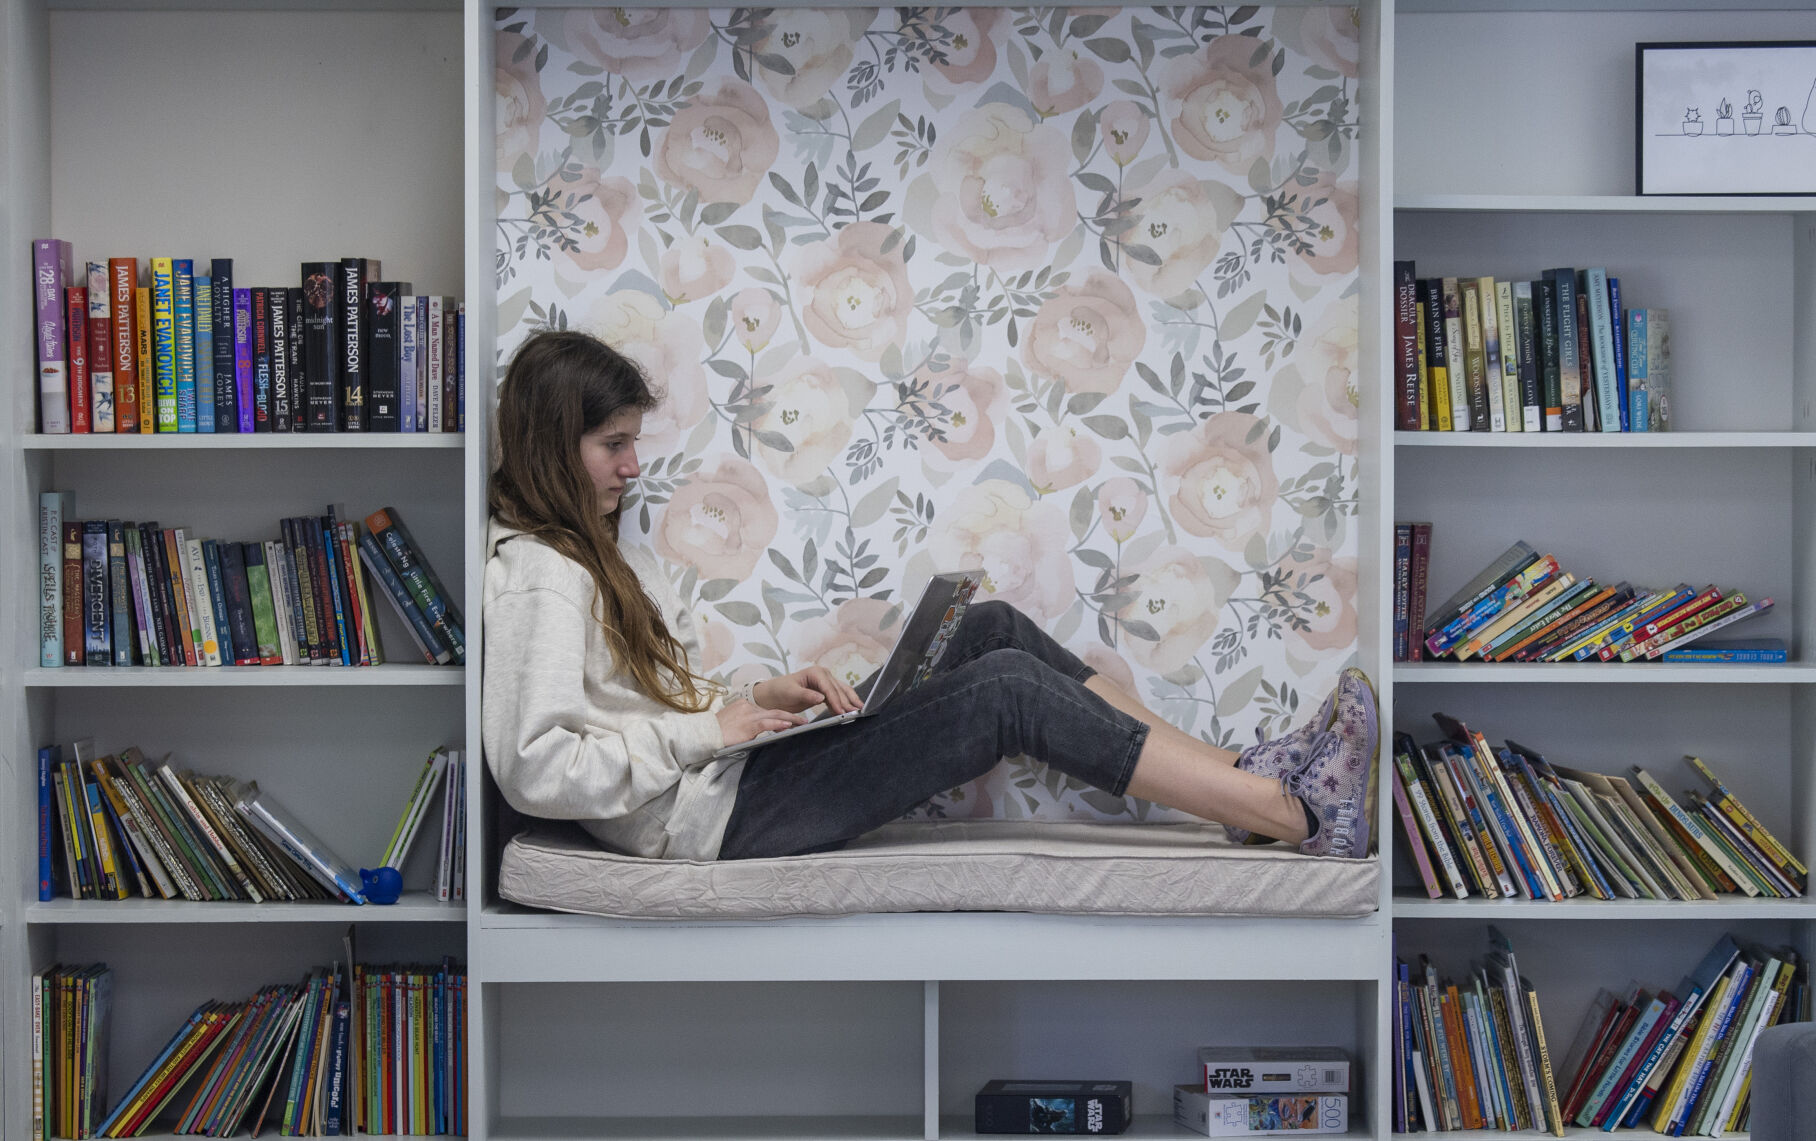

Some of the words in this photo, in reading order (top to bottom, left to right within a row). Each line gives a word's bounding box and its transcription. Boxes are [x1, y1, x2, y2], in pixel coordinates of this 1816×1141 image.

[38, 269, 55, 301] 28-DAY
[116, 266, 130, 301] JAMES
[154, 271, 171, 314] JANET
[175, 271, 192, 308] JANET
[196, 284, 212, 307] JANET
[345, 267, 357, 303] JAMES
[1561, 282, 1569, 301] THE
[222, 287, 230, 328] HIGHER
[256, 292, 264, 319] PATRICIA
[403, 304, 415, 321] The
[1399, 286, 1408, 322] DOSSIER
[1407, 283, 1416, 324] DRACULA
[1430, 288, 1439, 317] BRAIN
[198, 307, 212, 334] DAILEY
[235, 309, 246, 343] PATTERSON
[271, 305, 284, 337] JAMES
[305, 314, 333, 326] midnight
[1433, 320, 1440, 334] ON
[1521, 303, 1530, 334] Forever
[1562, 304, 1571, 337] FLIGHT
[118, 305, 131, 370] PATTERSON
[139, 329, 147, 354] MARS
[256, 320, 265, 353] CORNWELL
[347, 306, 358, 372] PATTERSON
[403, 324, 414, 343] Lost
[156, 319, 174, 395] EVANOVICH
[176, 314, 192, 382] EVANOVICH
[401, 345, 415, 362] Boy
[1434, 336, 1442, 358] FIRE
[1523, 338, 1532, 363] Amish
[1563, 340, 1573, 368] GIRLS
[257, 363, 269, 388] FLESH
[273, 339, 286, 398] PATTERSON
[216, 373, 224, 407] COMEY
[1470, 355, 1483, 409] WOODSMALL
[1601, 371, 1611, 410] YESTERDAYS
[120, 388, 135, 403] 13
[178, 390, 186, 420] SHARP
[255, 394, 267, 421] BLOOD
[275, 400, 288, 412] 15
[159, 414, 176, 424] TOP
[191, 546, 200, 561] AVI
[42, 564, 56, 601] SPELLS
[386, 532, 404, 556] Celeste
[401, 556, 409, 568] Ng
[409, 572, 423, 589] Little
[421, 589, 433, 606] Fires
[431, 606, 458, 646] Everywhere
[89, 559, 105, 643] DIVERGENT
[1560, 602, 1573, 614] The
[1528, 618, 1546, 632] Eater
[157, 631, 166, 655] GAIMAN
[1414, 789, 1423, 798] 99
[1418, 798, 1432, 821] Stories
[1668, 802, 1703, 840] DINOSAURS
[186, 799, 201, 819] Calvin
[199, 818, 209, 830] and
[206, 828, 224, 851] Hobbes
[1427, 820, 1440, 839] from
[1435, 839, 1445, 852] the
[1529, 814, 1548, 842] RAMONA
[1543, 841, 1564, 872] FOREVER
[1441, 852, 1453, 870] Bible
[1724, 1015, 1731, 1023] Do
[1727, 1005, 1735, 1016] What
[1636, 1021, 1648, 1037] Bible
[1662, 1031, 1672, 1043] THE
[1716, 1032, 1723, 1040] Do
[1720, 1022, 1728, 1032] You
[1622, 1035, 1640, 1058] Stories
[1649, 1054, 1657, 1062] IN
[1655, 1042, 1665, 1054] CAT
[333, 1049, 342, 1070] grumpy
[1443, 1063, 1449, 1072] BY
[1617, 1055, 1627, 1066] for
[1642, 1061, 1652, 1072] THE
[1703, 1060, 1711, 1070] With
[1209, 1068, 1254, 1078] STAR
[1209, 1079, 1254, 1088] WARS
[1540, 1045, 1551, 1074] STORM'S
[1546, 1075, 1556, 1102] COMING
[1607, 1064, 1621, 1082] Little
[1634, 1071, 1646, 1084] HAT
[1596, 1079, 1611, 1098] Hands
[1688, 1090, 1697, 1105] This?
[1694, 1080, 1702, 1091] Like
[1087, 1100, 1098, 1132] WARS
[1094, 1099, 1102, 1130] STAR
[1325, 1097, 1341, 1128] 500
